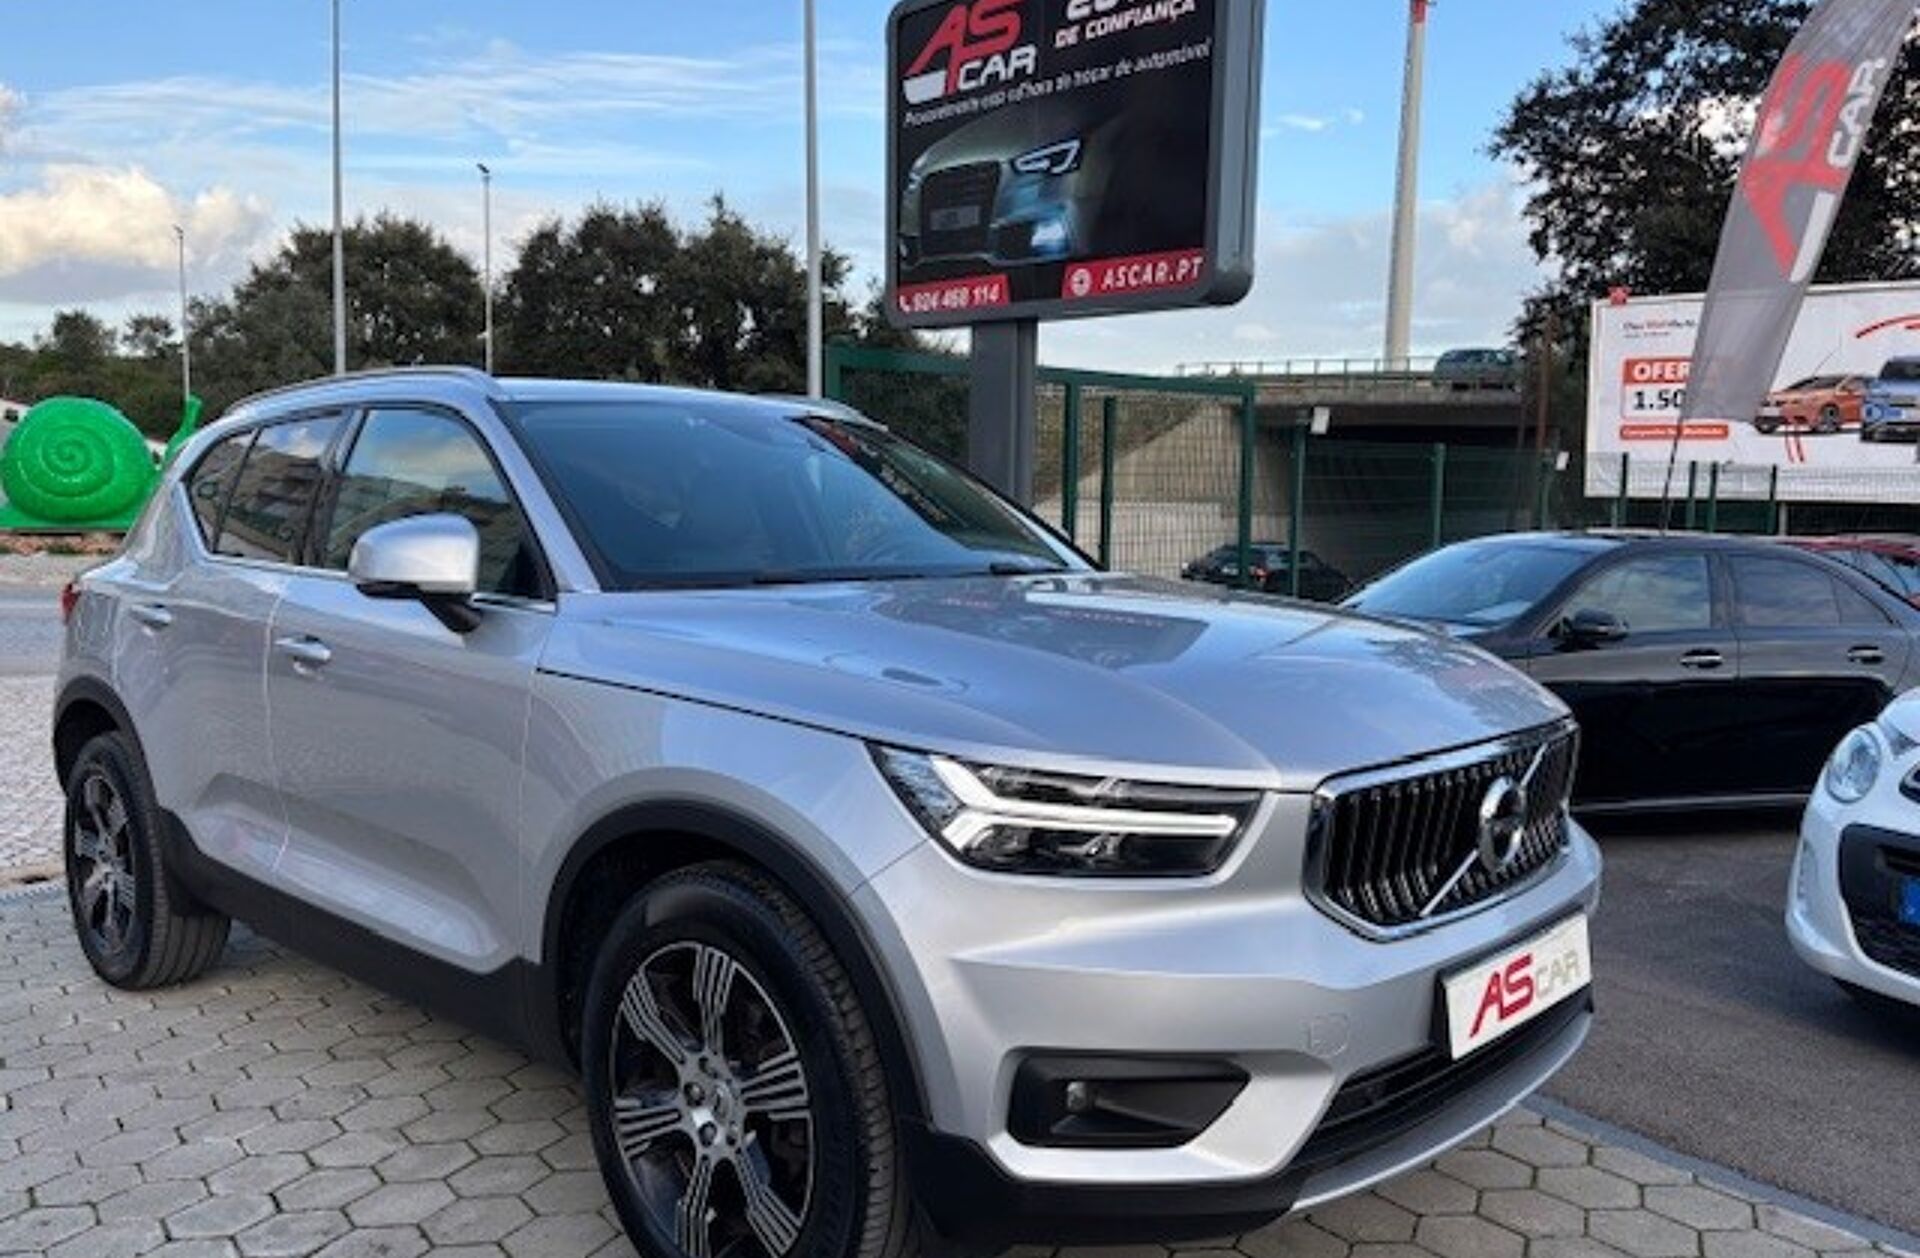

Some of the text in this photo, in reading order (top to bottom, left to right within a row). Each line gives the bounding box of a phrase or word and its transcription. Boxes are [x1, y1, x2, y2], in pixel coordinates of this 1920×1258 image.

[904, 0, 1022, 95] AS
[1055, 0, 1196, 48] DE CONFIANÇA
[957, 44, 1037, 91] CAR
[1827, 58, 1888, 167] CAR
[1101, 256, 1203, 290] ASCAR.PT
[1633, 361, 1691, 381] OFER
[1469, 948, 1580, 1038] AS CAR
